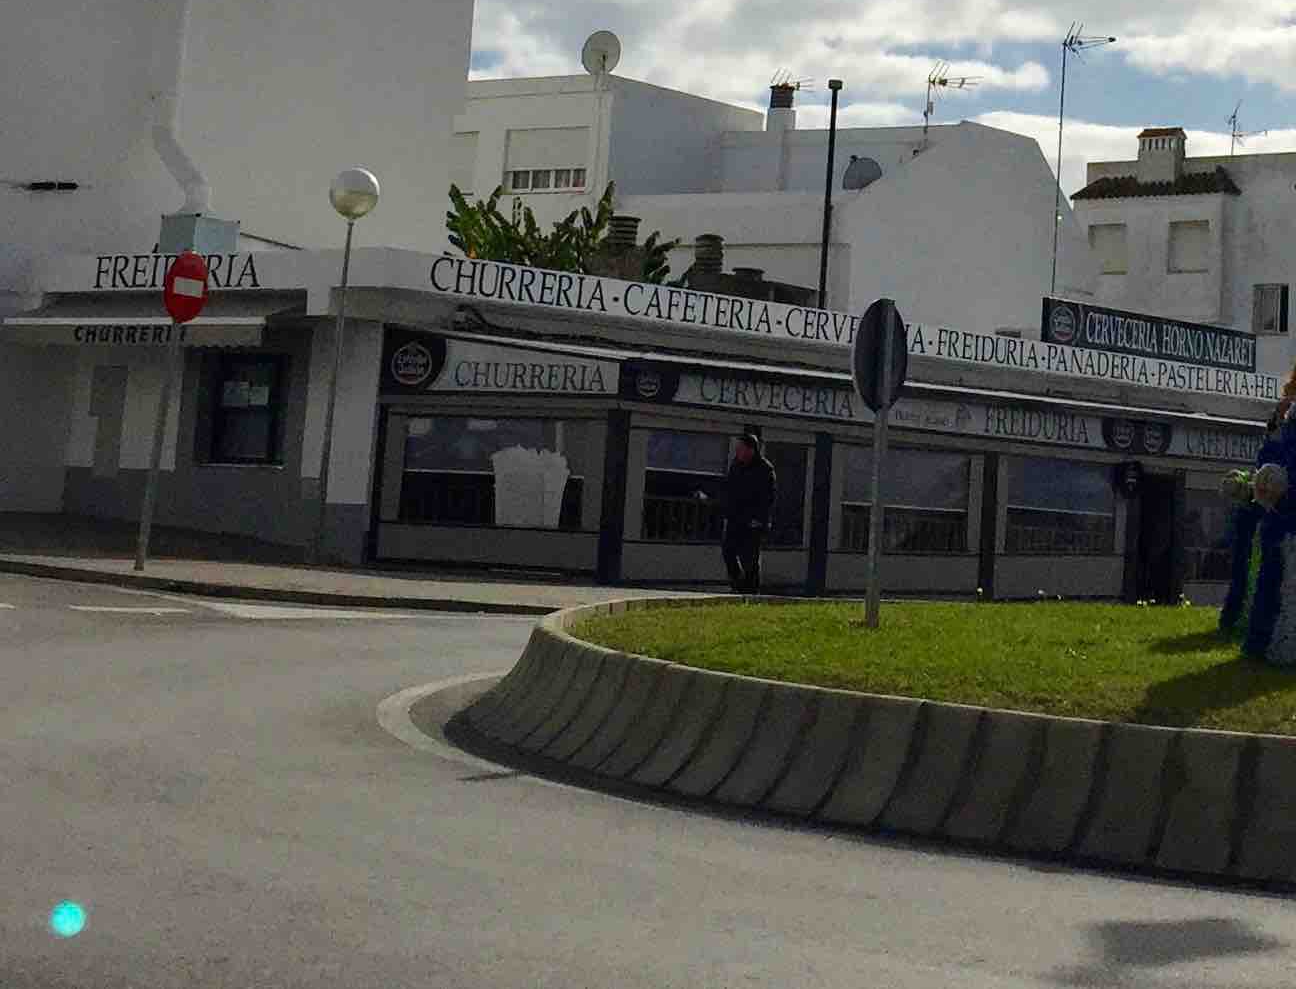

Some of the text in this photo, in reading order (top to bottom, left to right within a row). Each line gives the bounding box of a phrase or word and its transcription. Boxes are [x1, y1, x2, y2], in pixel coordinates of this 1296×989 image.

[93, 243, 260, 289] FREÍRIA
[431, 257, 608, 312] CHURRERIA
[624, 283, 772, 334] CAFETERIA
[786, 307, 925, 354] CERVEA
[936, 328, 1039, 369] FREIDURIA
[1047, 344, 1150, 384] PANADERIA
[1158, 362, 1250, 396] PASTELERIA
[1086, 311, 1255, 367] CERVECERIA HORNO NAZARET
[454, 361, 607, 392] CHURRERIA
[700, 373, 853, 418] CERVECERIA
[985, 404, 1089, 444] FREIDURIA
